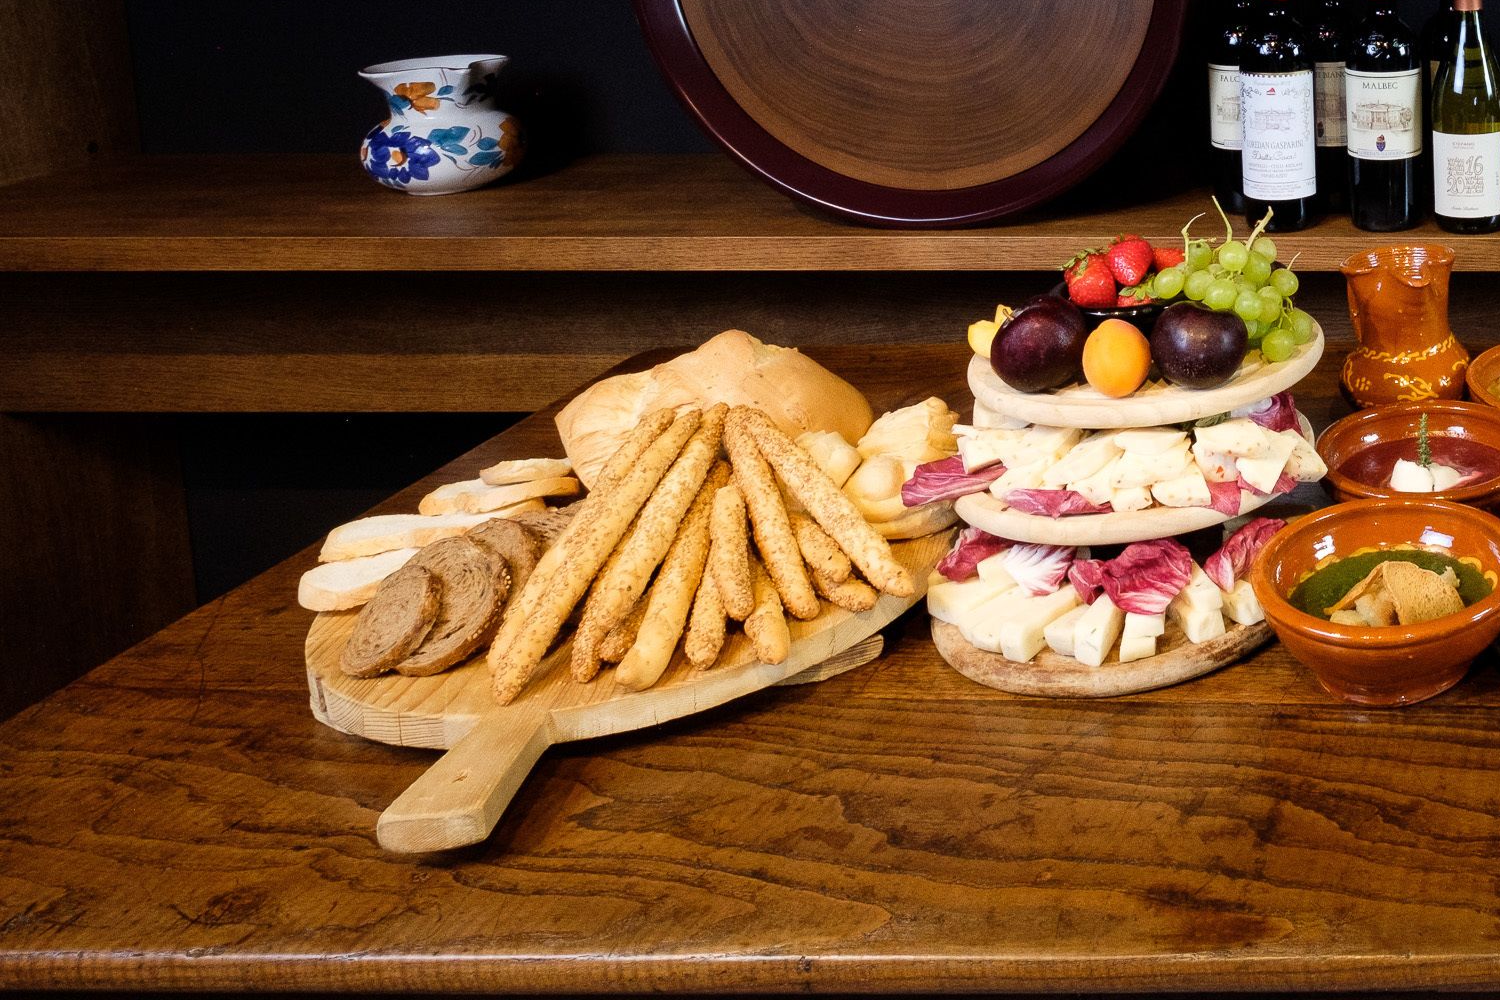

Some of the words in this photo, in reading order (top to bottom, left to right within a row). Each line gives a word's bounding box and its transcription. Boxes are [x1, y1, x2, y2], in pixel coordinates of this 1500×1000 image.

[1363, 82, 1399, 90] MALBEC
[1464, 155, 1484, 176] 16
[1446, 174, 1464, 194] 20
